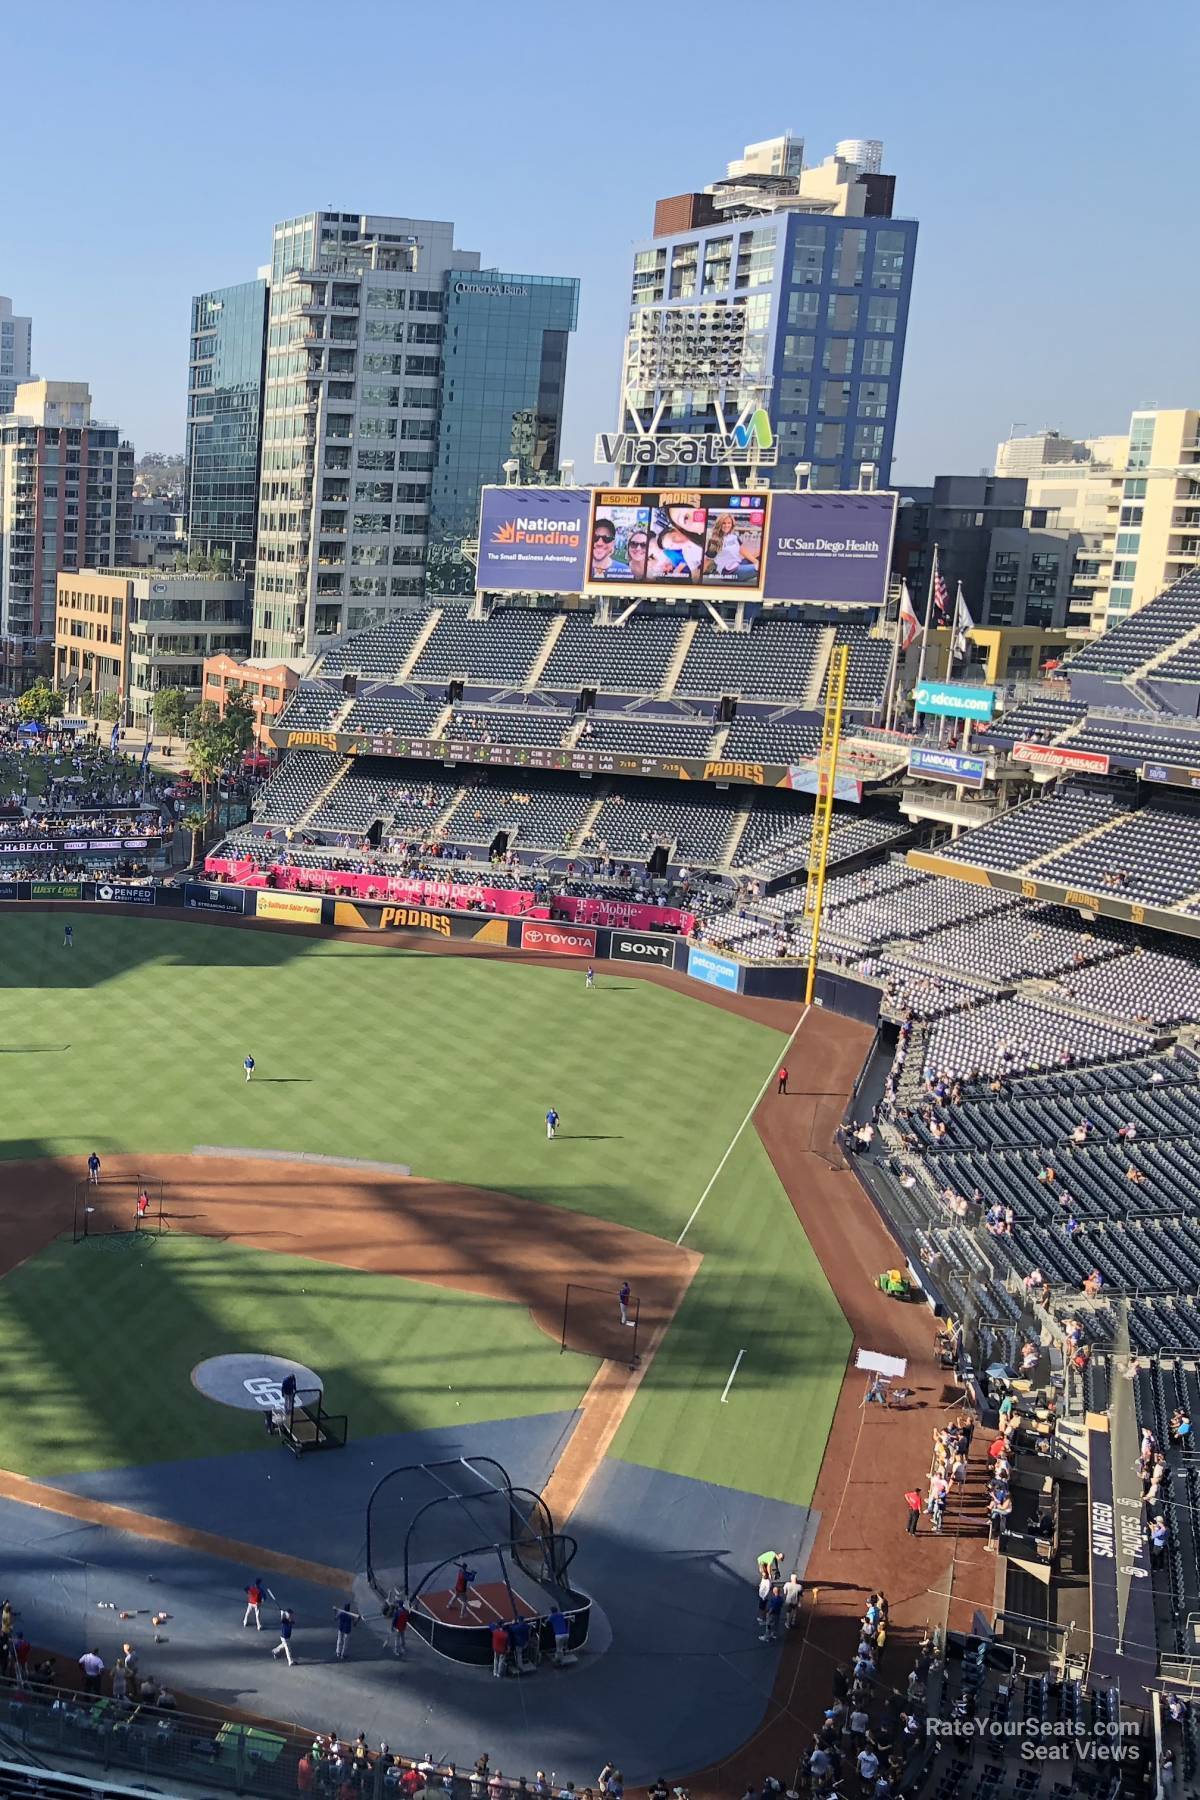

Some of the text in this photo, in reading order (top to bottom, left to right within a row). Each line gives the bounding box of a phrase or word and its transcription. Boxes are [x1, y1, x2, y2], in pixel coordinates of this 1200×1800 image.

[503, 284, 527, 296] Bank
[517, 518, 580, 531] National
[516, 531, 580, 547] Funding
[795, 538, 814, 550] San
[816, 539, 844, 552] Diego
[845, 540, 879, 552] Health
[500, 553, 517, 561] Small
[544, 554, 577, 563] Advantage
[931, 692, 988, 711] sdccu.com
[287, 731, 337, 751] PADRES
[1015, 746, 1105, 771] Tarantino SAUSAGES
[703, 762, 764, 785] PADRES
[300, 869, 332, 882] Mobile
[115, 888, 151, 898] PENFED
[388, 879, 485, 900] HOME RUN DECK
[304, 905, 320, 913] Power
[1064, 891, 1099, 911] PADRES
[599, 902, 637, 917] Mobile
[380, 907, 450, 936] PADRES
[545, 933, 593, 948] TOYOTA
[620, 942, 670, 958] SONY
[692, 953, 734, 977] petco.com
[1093, 1501, 1113, 1558] SAN DIEGO
[1120, 1515, 1143, 1558] PADRES
